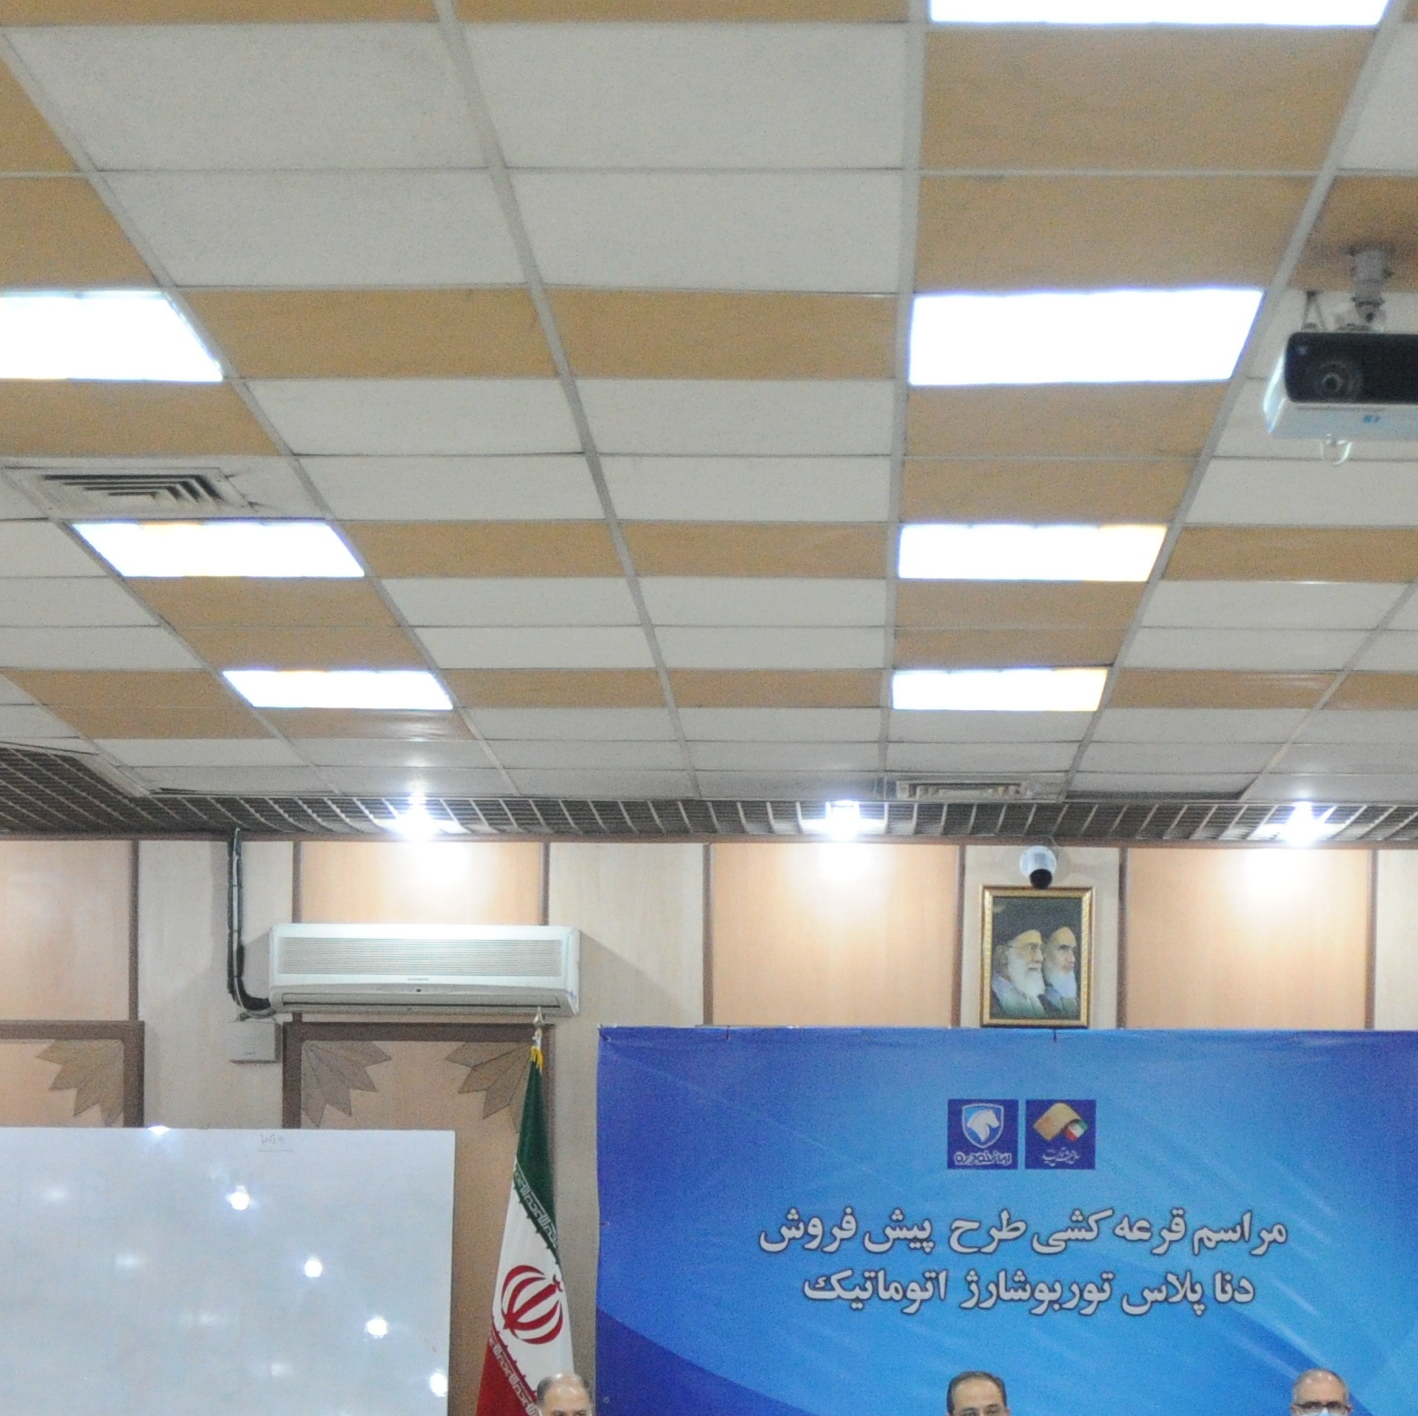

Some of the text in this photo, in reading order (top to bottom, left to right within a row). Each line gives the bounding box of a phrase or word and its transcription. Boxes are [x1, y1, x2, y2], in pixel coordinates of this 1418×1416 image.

[759, 1206, 1287, 1255] مراسم قرعه کشی طرح پیش فروش
[803, 1269, 1255, 1316] دنا پلاس توربوشارژ اتوماتیک
